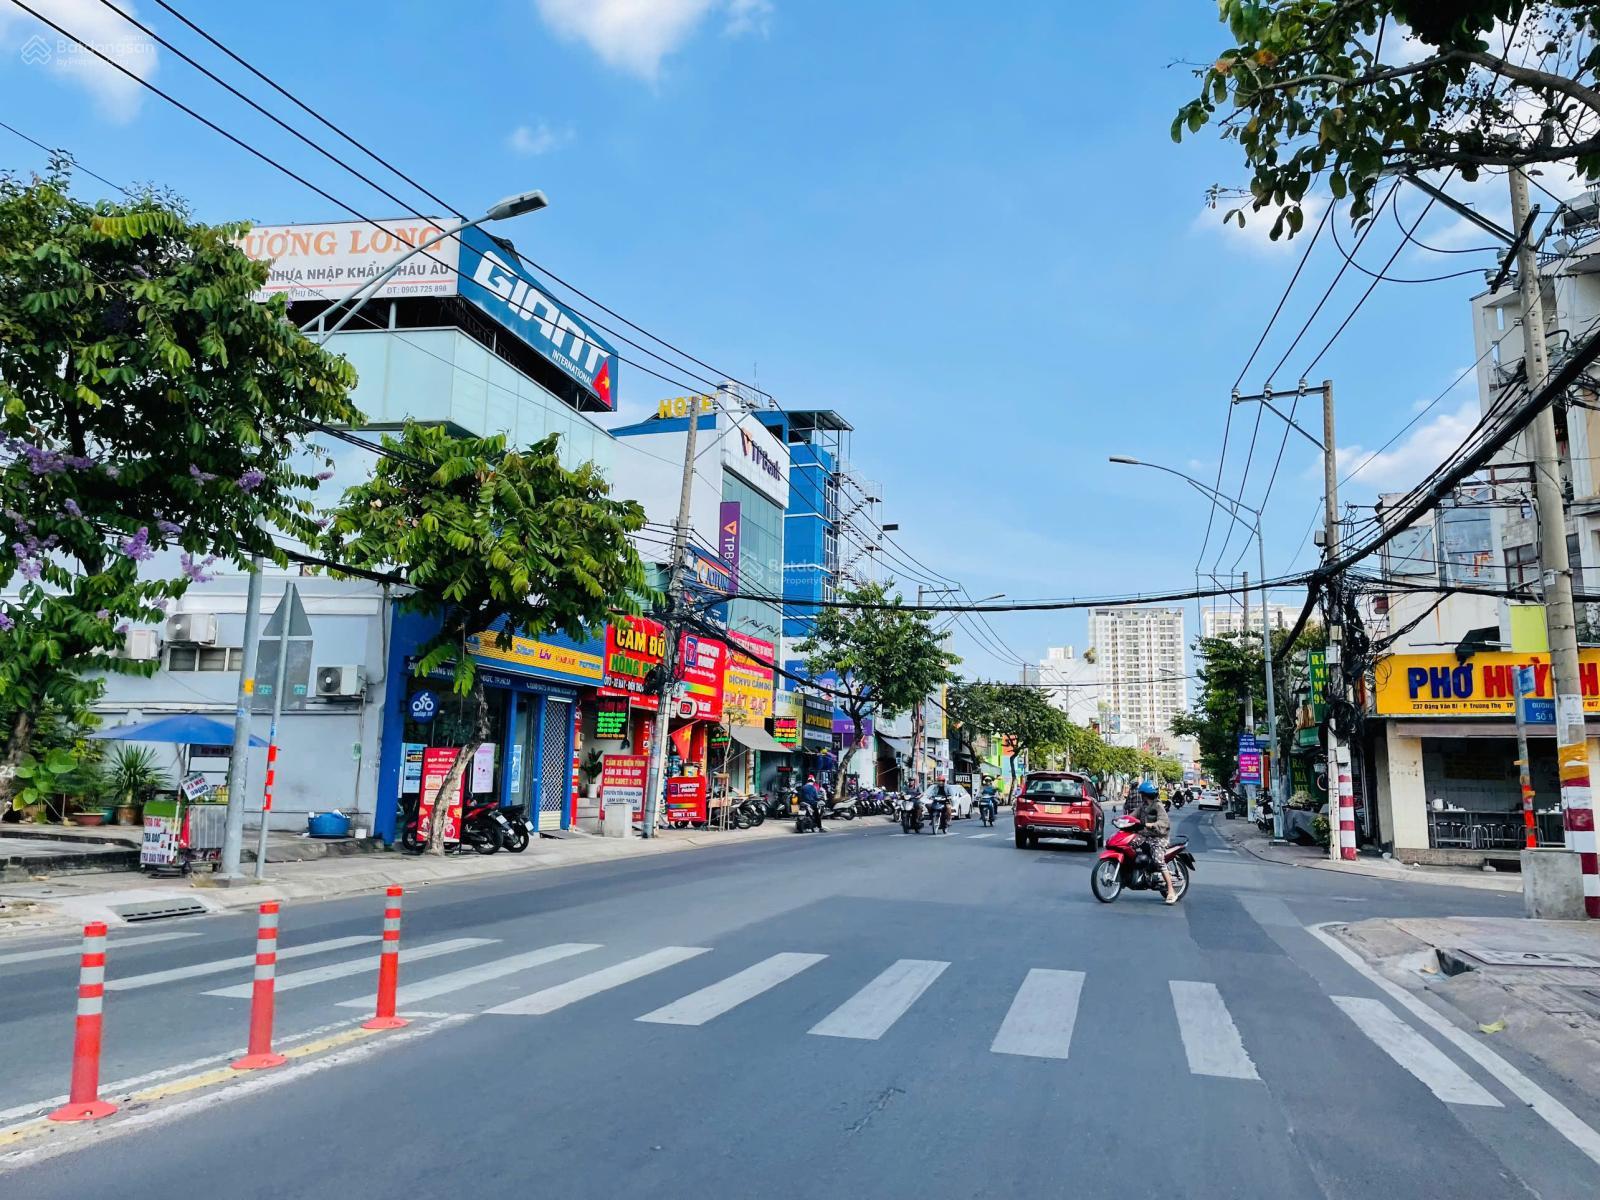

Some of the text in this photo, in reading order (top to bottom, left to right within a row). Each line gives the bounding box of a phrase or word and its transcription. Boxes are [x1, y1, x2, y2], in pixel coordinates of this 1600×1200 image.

[349, 226, 442, 255] LONG
[307, 264, 343, 282] NHẬP
[393, 261, 428, 277] HÂU
[430, 262, 449, 275] ÂU
[401, 285, 419, 294] 0903
[420, 285, 432, 293] 725
[473, 250, 611, 373] GIANT
[551, 349, 593, 387] INTERNATIONAL
